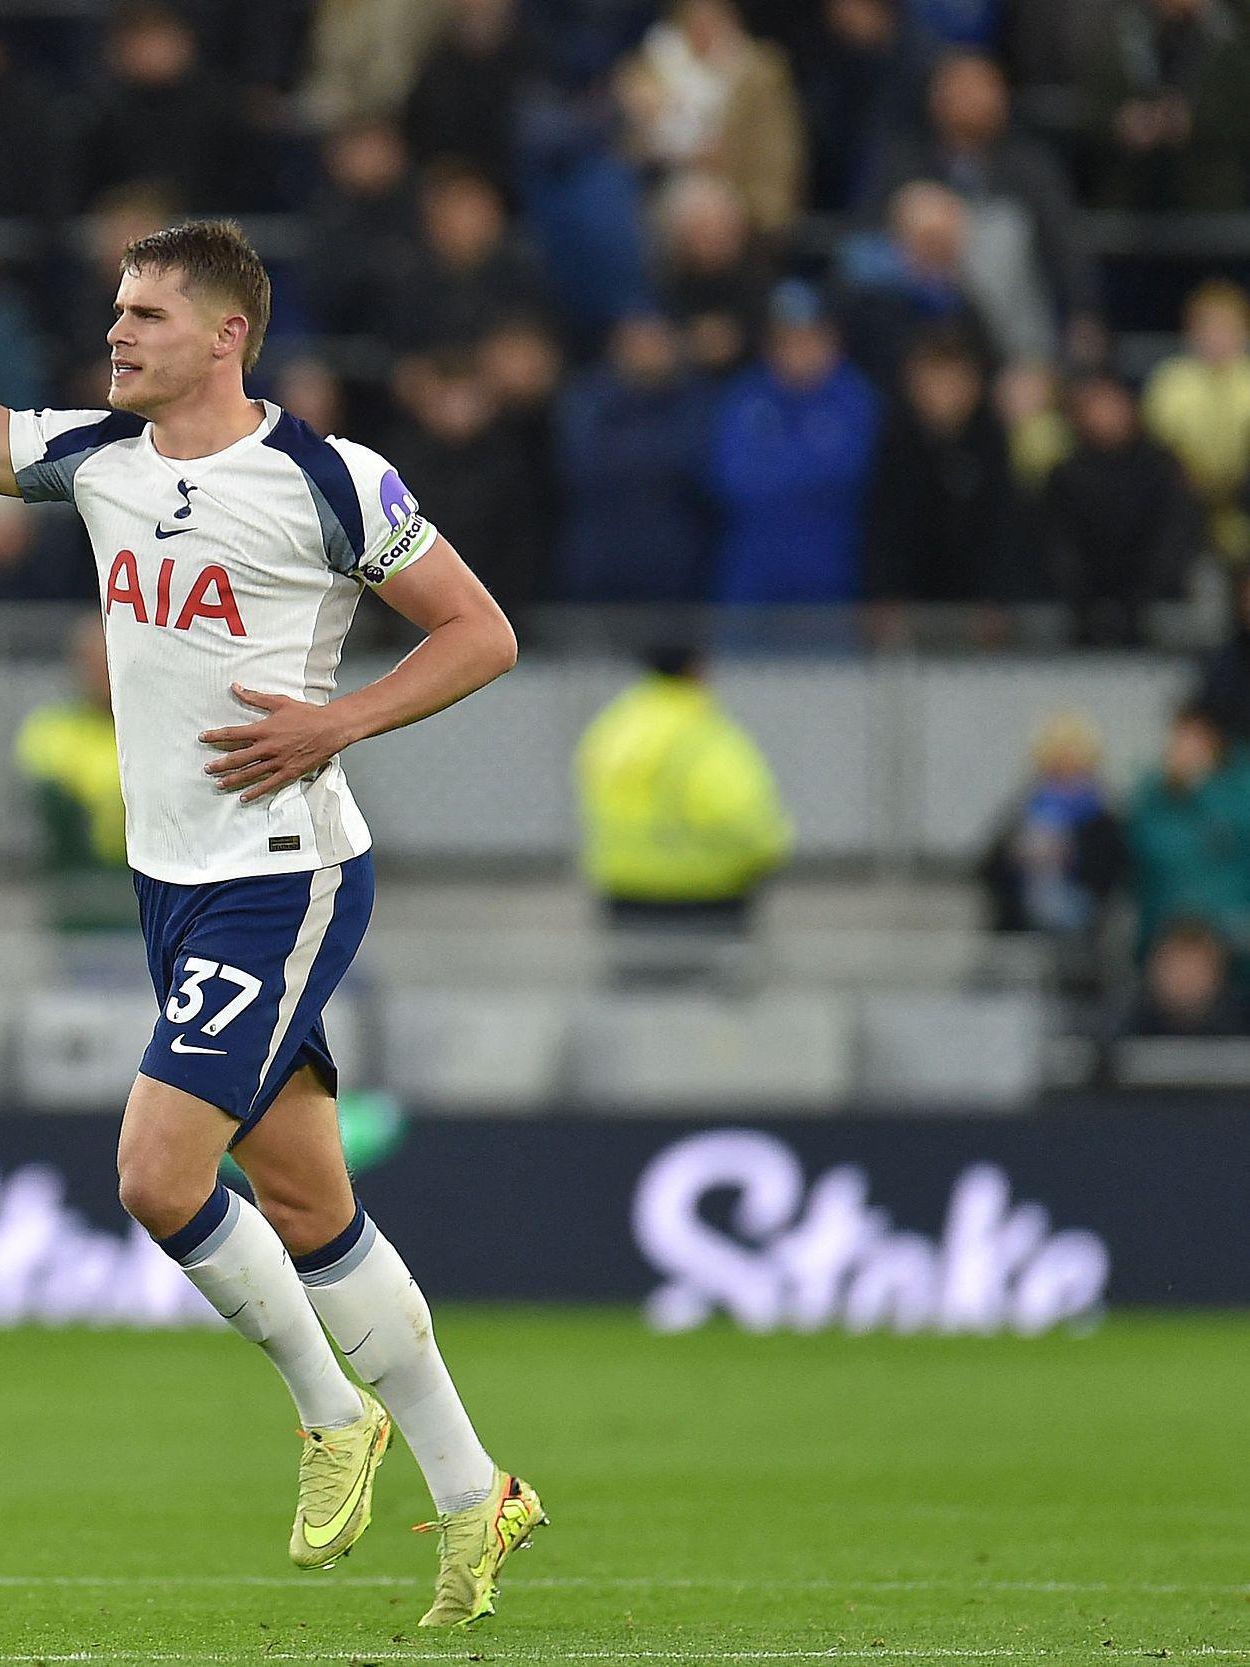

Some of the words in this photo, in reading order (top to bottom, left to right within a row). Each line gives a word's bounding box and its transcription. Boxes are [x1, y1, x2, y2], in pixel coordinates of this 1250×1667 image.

[106, 549, 247, 637] AIA
[166, 957, 263, 1037] 37
[632, 1128, 1111, 1336] Stake
